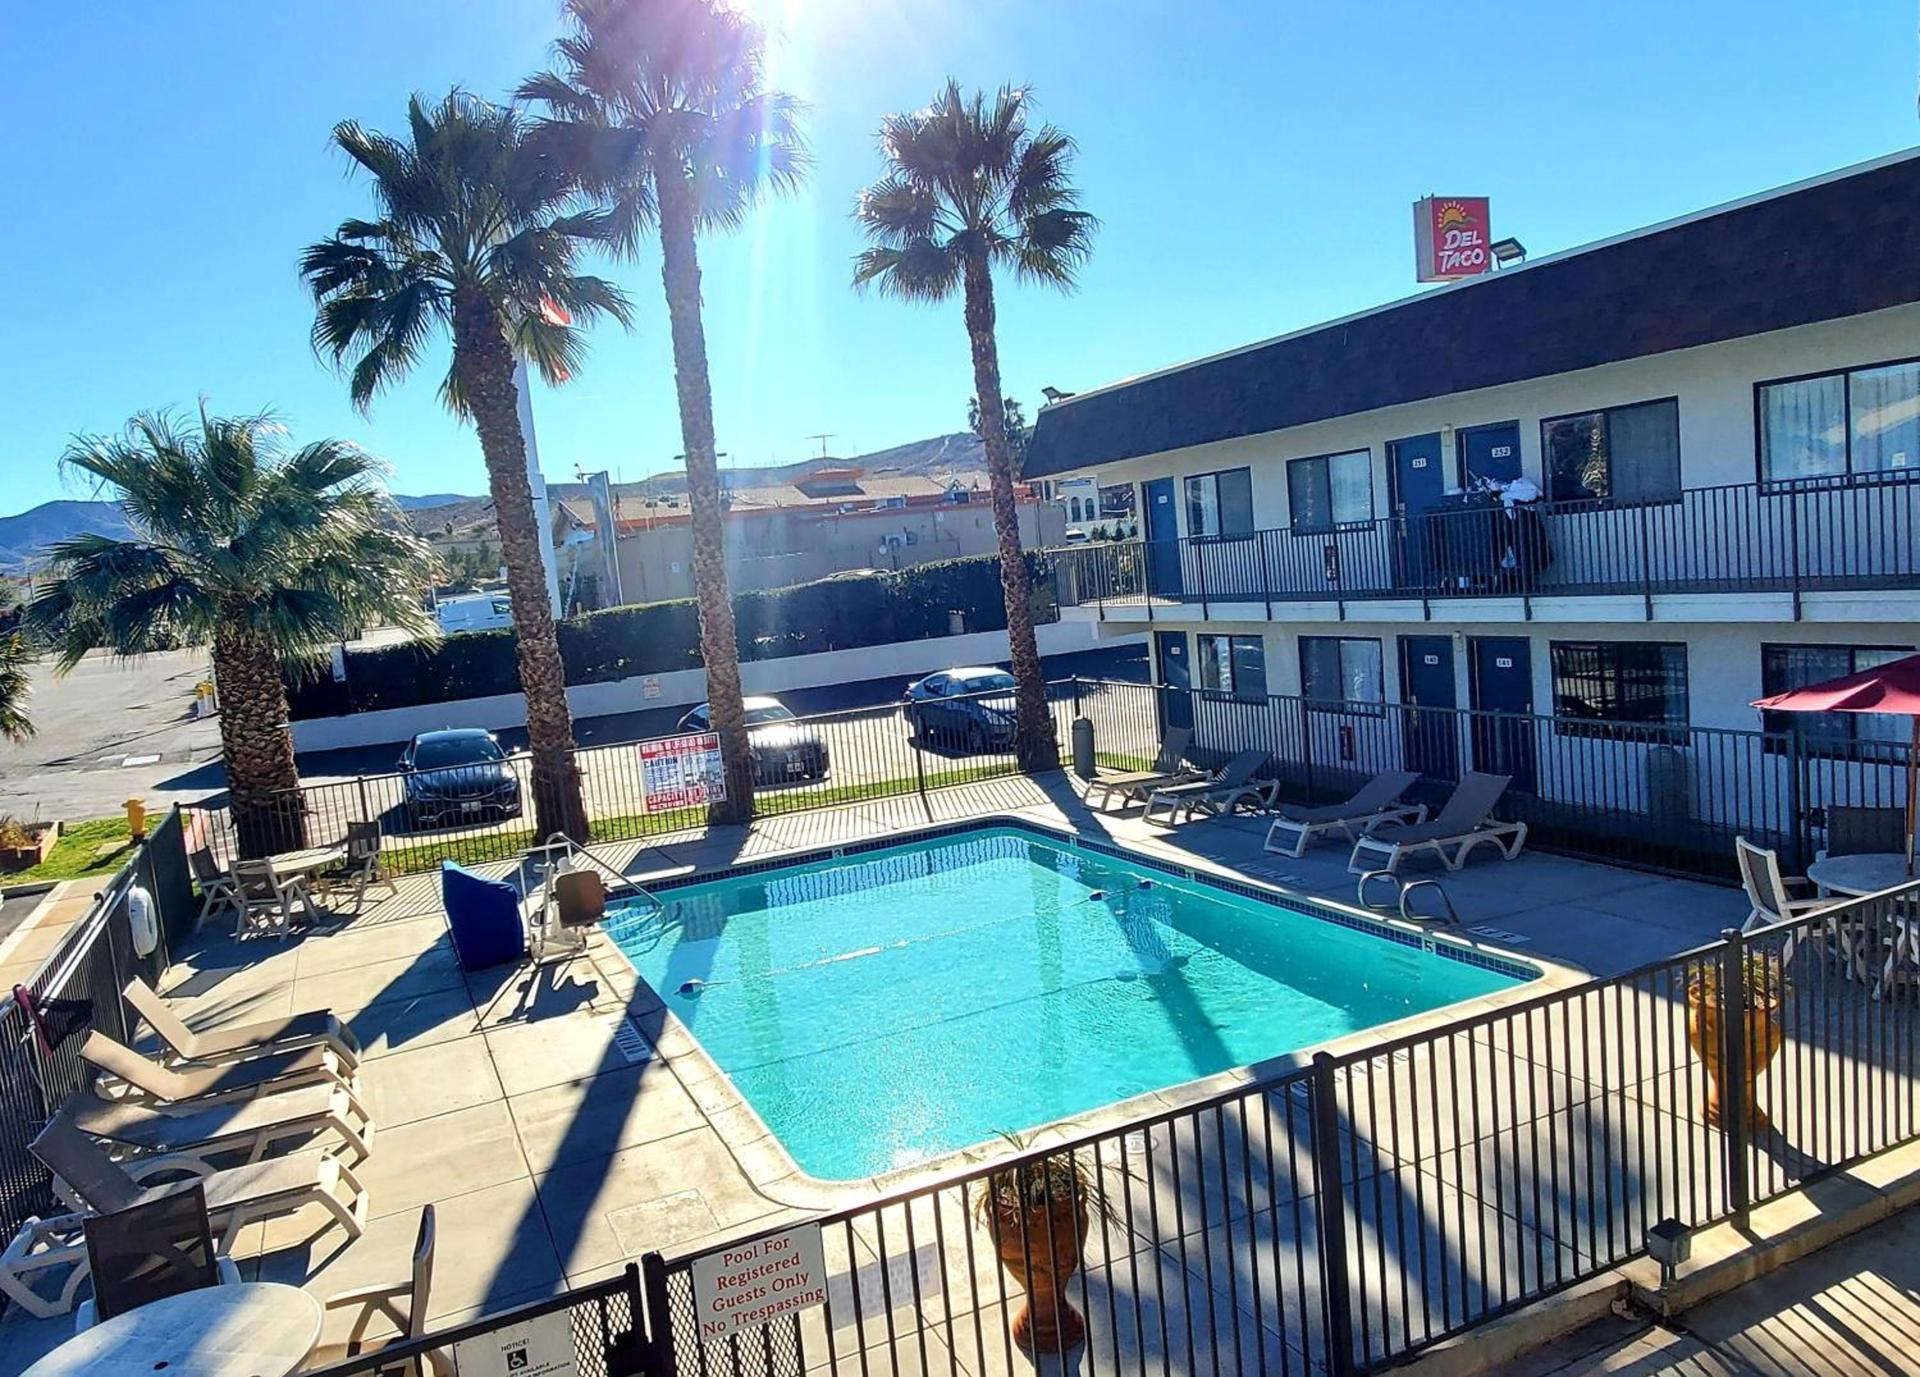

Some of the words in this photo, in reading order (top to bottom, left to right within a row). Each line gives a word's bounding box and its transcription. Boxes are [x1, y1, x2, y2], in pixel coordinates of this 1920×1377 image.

[1444, 230, 1482, 249] DEL
[1439, 248, 1484, 272] TACO
[644, 756, 678, 768] CAUTION
[648, 791, 683, 804] CAPACITY
[1424, 940, 1433, 952] 5
[723, 1246, 758, 1267] Pool
[763, 1238, 790, 1255] For
[716, 1252, 800, 1291] Registered
[712, 1286, 767, 1312] Guests
[772, 1272, 809, 1292] Only
[703, 1321, 726, 1336] No
[731, 1288, 825, 1326] Trespassing
[501, 1338, 530, 1352] NOTICE!
